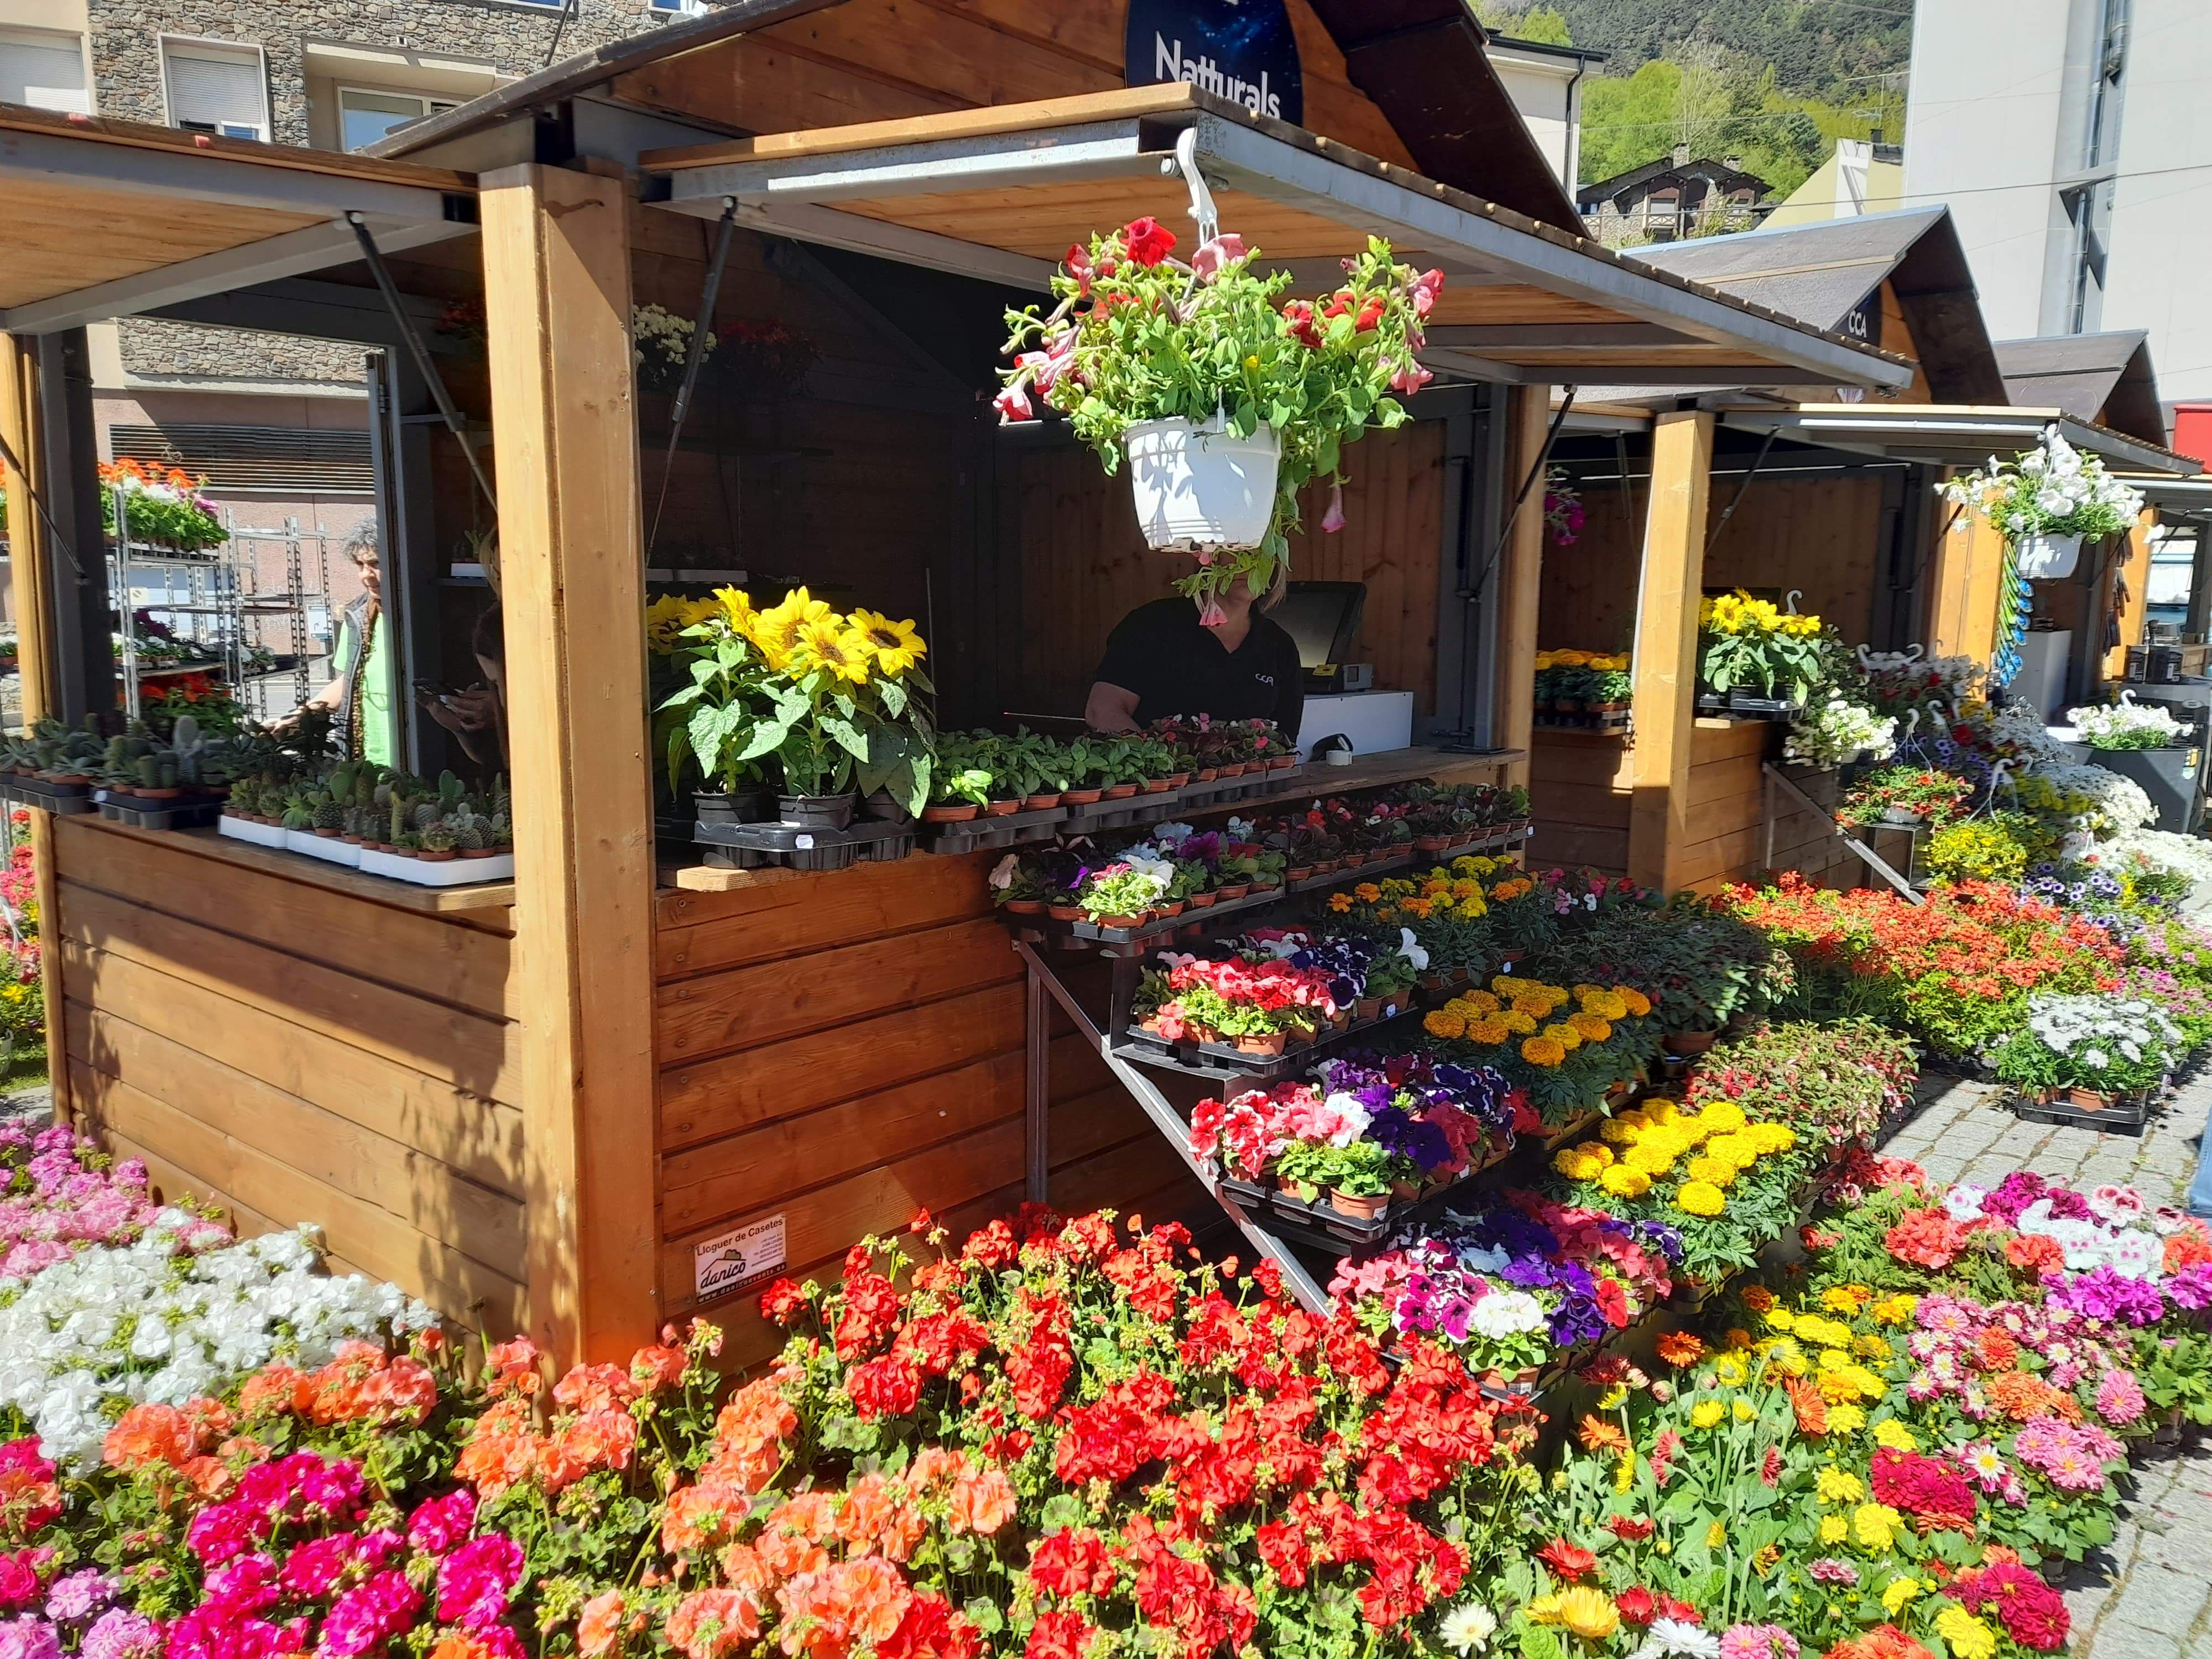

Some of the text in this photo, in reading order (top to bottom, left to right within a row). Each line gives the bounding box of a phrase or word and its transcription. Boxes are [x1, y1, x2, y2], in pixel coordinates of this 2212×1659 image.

[1155, 30, 1281, 119] Natturals
[1848, 310, 1867, 338] CCA
[697, 1237, 733, 1256] Lloguer
[735, 1232, 746, 1242] de
[748, 1218, 783, 1237] Casetes
[700, 1262, 746, 1289] danico
